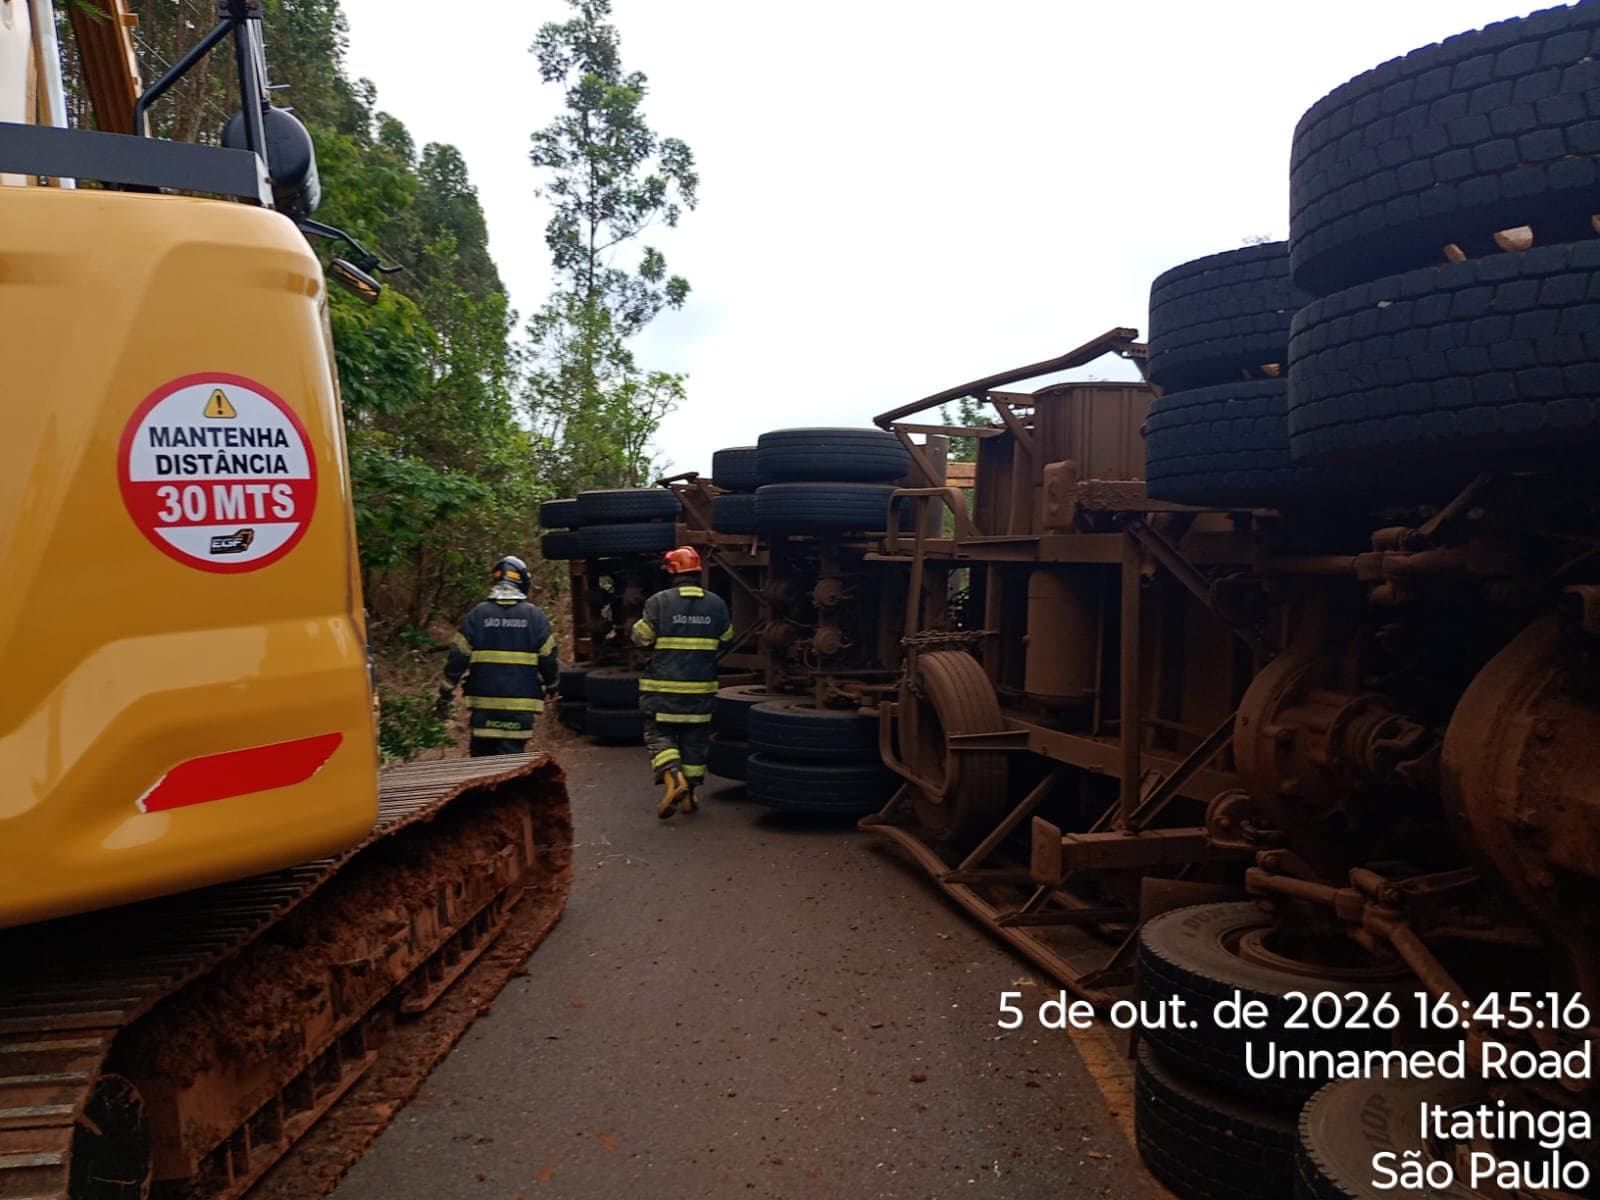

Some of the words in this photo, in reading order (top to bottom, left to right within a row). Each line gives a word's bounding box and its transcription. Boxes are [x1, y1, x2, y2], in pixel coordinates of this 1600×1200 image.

[149, 427, 290, 448] MANTENHA
[156, 450, 289, 475] DISTÂNCIA
[157, 485, 207, 523] 30
[213, 483, 295, 521] MTS
[484, 617, 501, 628] SÃO
[502, 617, 528, 628] PAULO
[672, 614, 688, 625] SÃO
[688, 615, 712, 625] PAULO
